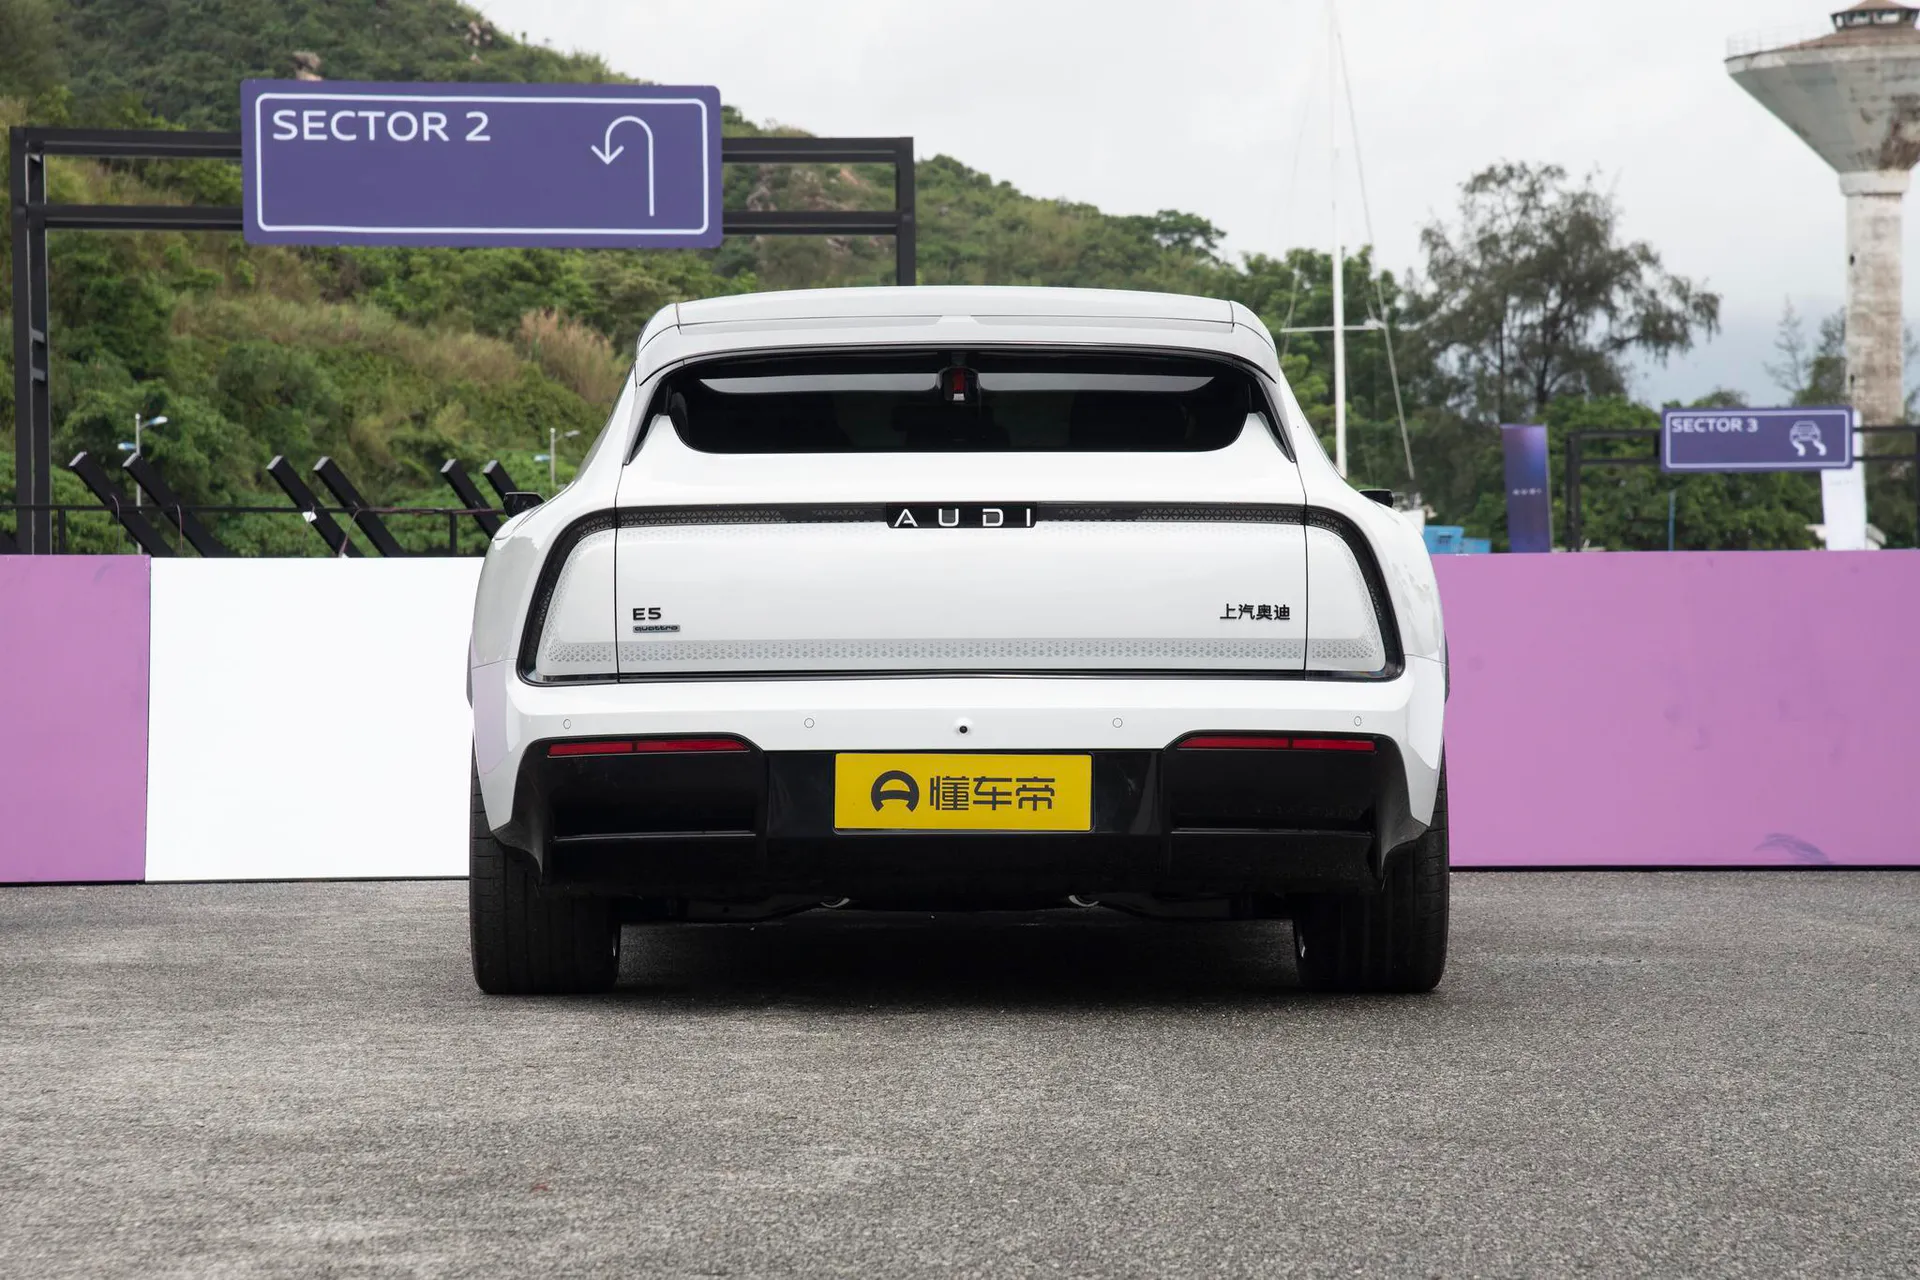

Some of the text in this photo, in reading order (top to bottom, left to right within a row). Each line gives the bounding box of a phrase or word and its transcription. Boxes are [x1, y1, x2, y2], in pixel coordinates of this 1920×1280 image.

[272, 109, 491, 142] SECTOR 2
[1671, 417, 1759, 433] SECTOR 3
[893, 508, 1031, 527] AUDI
[632, 607, 662, 620] E5
[1219, 603, 1291, 621] 上汽奥迪
[633, 625, 679, 633] quattro
[929, 775, 1056, 812] 懂车帝
